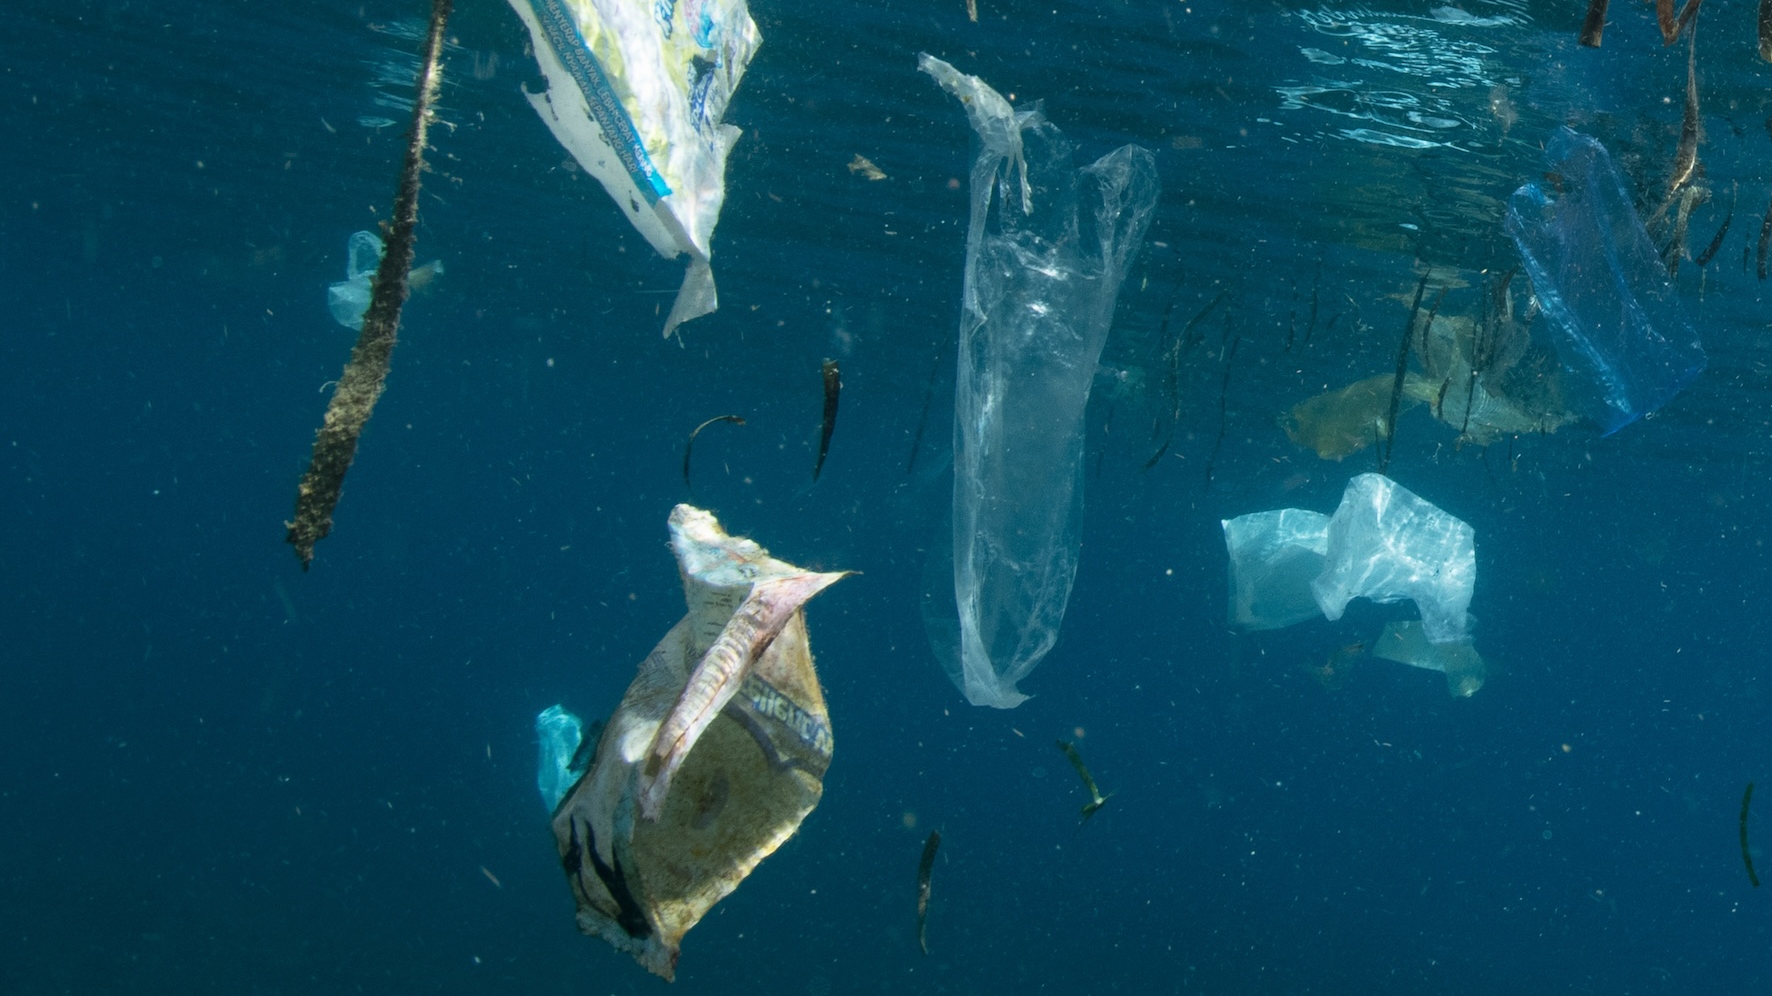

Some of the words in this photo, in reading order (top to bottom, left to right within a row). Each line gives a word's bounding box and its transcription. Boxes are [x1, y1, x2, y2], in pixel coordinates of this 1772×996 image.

[545, 23, 566, 51] KECIL
[562, 51, 592, 96] NYAMAN
[586, 94, 624, 149] SEPANJANG
[619, 149, 638, 174] HARI
[597, 86, 617, 114] LEBIH
[612, 111, 635, 144] CEPAT
